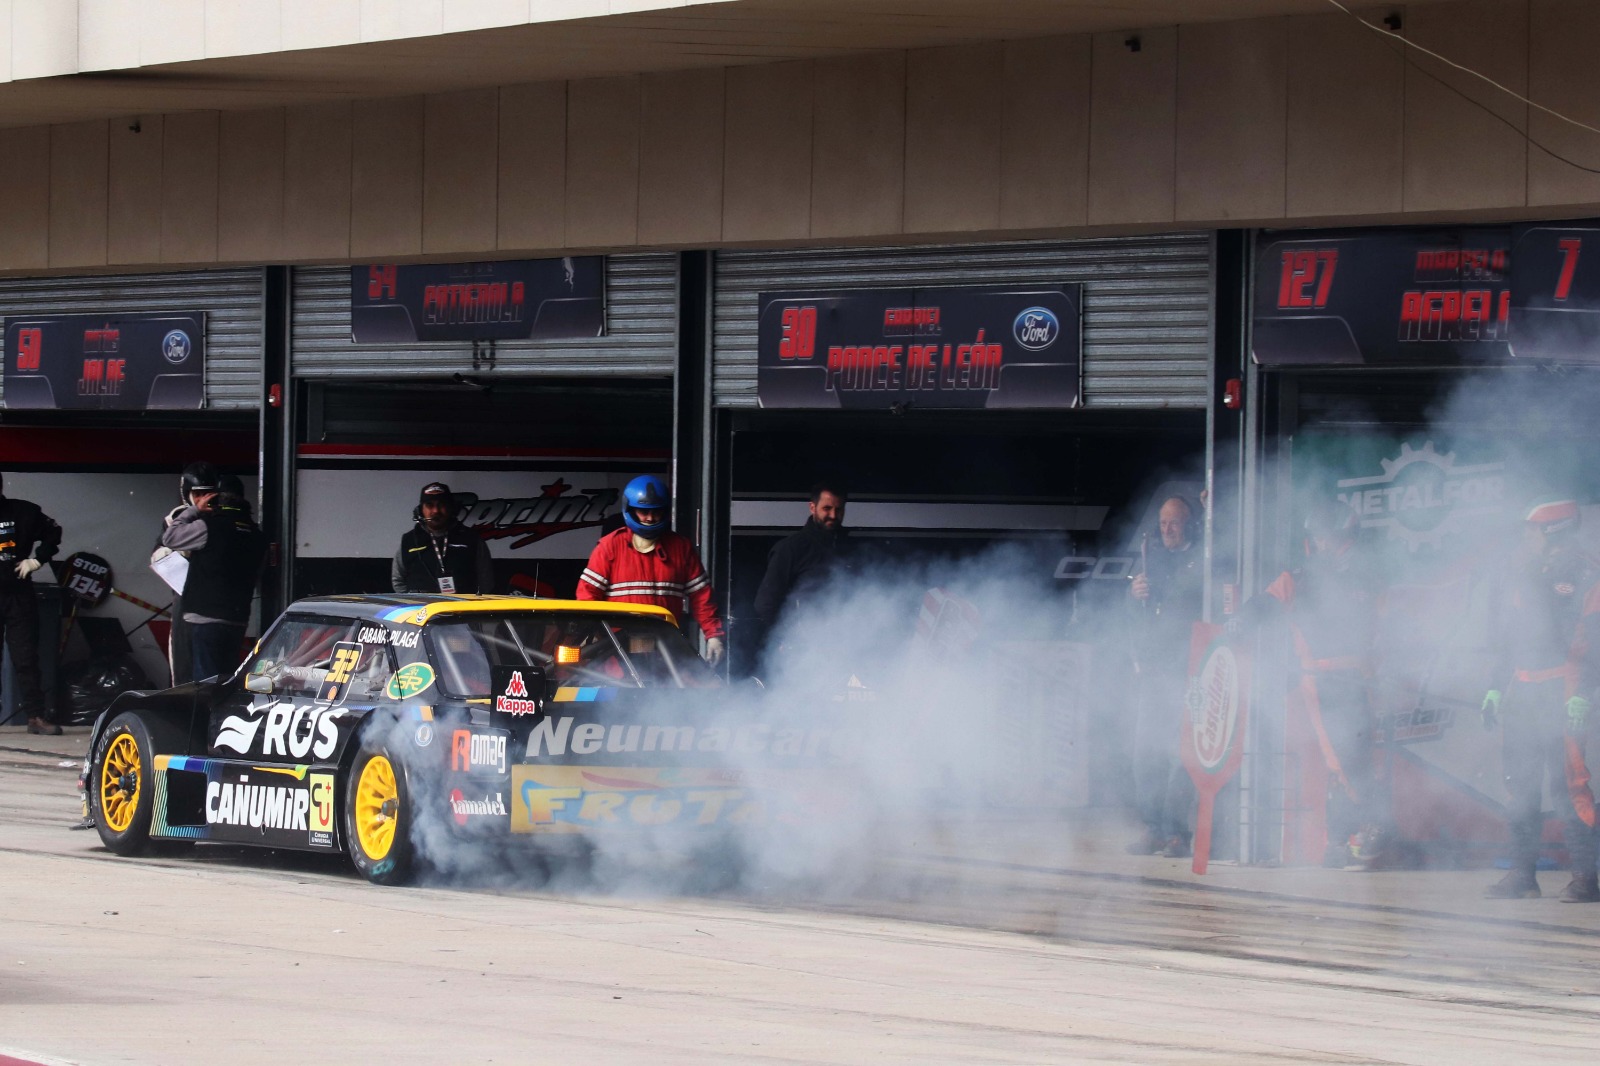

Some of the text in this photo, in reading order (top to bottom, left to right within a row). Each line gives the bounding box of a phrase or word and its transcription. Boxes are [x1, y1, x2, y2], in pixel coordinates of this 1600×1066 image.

[368, 263, 398, 299] 54
[1277, 248, 1339, 309] 127
[1554, 237, 1582, 301] 7
[423, 281, 525, 325] COTIGNOLA
[166, 334, 190, 359] Ford
[778, 305, 818, 360] 30
[1020, 314, 1051, 343] Ford
[16, 327, 42, 372] 50
[825, 327, 1004, 392] PONCE DE LEÓN
[1338, 475, 1504, 516] METALFOR
[73, 557, 108, 575] STOP
[68, 573, 104, 598] 134
[389, 628, 423, 649] PILAGÁ
[325, 648, 360, 684] 32
[394, 674, 424, 691] SR
[496, 695, 536, 717] Kappa
[1194, 654, 1228, 761] Castellano
[262, 702, 350, 760] RUS
[451, 729, 507, 774] Romag
[449, 792, 508, 816] tamatel
